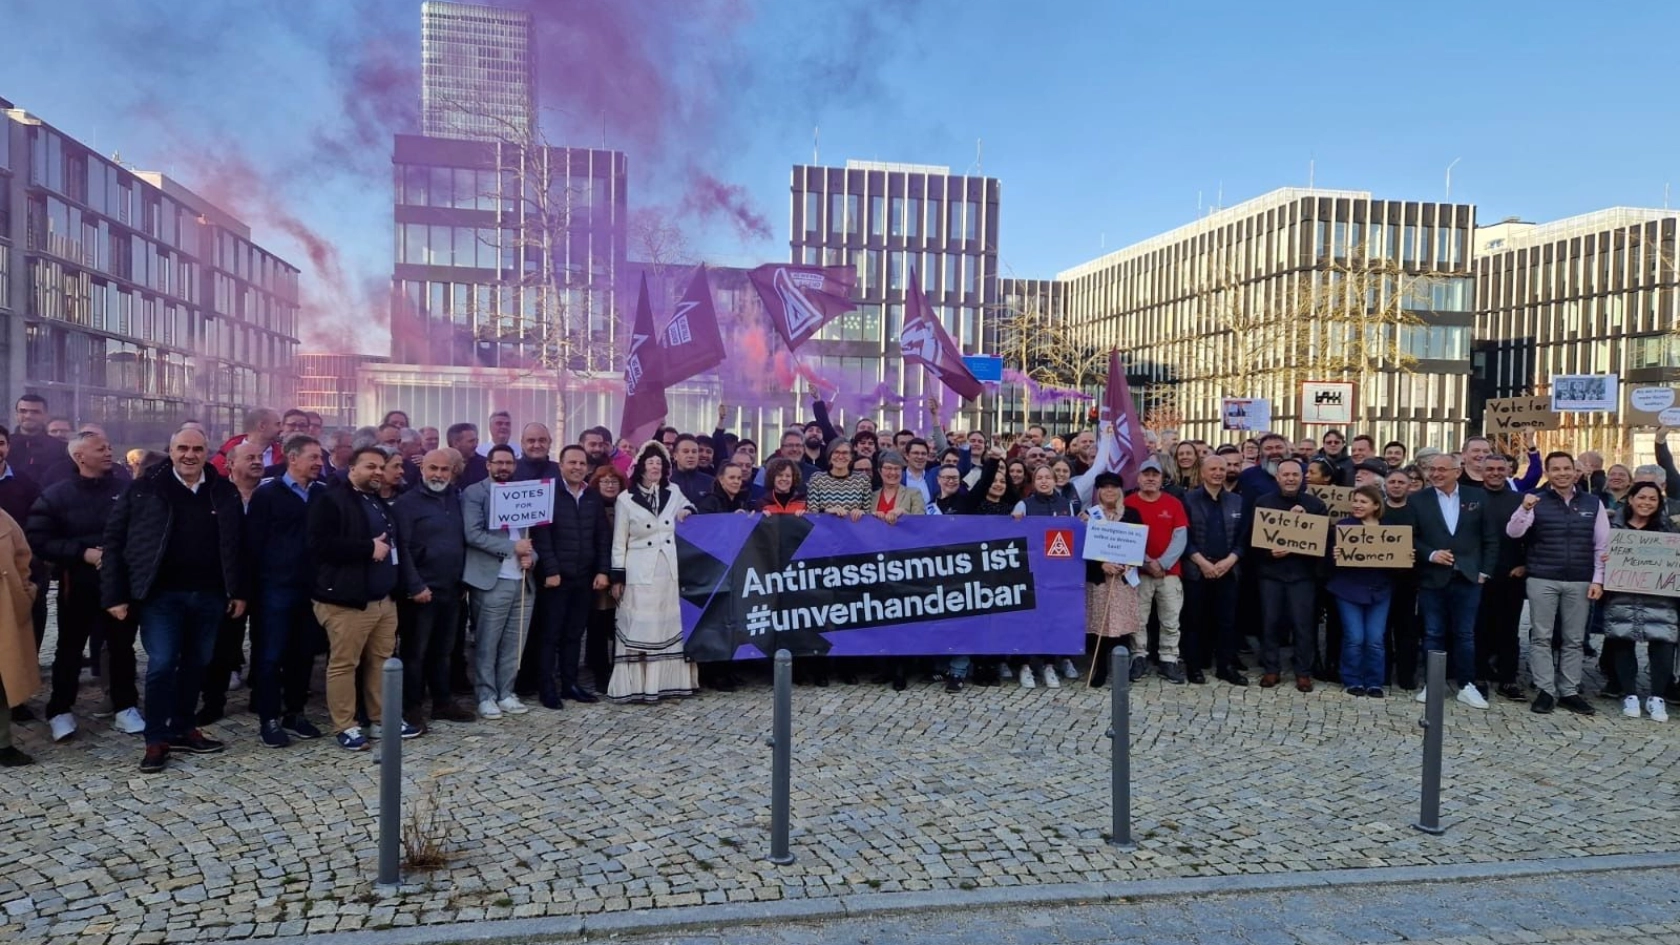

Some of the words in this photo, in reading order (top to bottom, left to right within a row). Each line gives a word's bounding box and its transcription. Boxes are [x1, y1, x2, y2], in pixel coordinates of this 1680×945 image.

[1490, 401, 1523, 413] Vote
[1529, 400, 1548, 411] for
[1496, 416, 1545, 428] Women
[503, 489, 544, 500] VOTES
[1311, 487, 1343, 501] Vote
[498, 510, 545, 522] WOMEN
[1260, 511, 1290, 526] Vote
[1294, 515, 1314, 529] for
[1263, 528, 1317, 551] Women
[1338, 527, 1374, 544] Vote
[1381, 529, 1402, 543] for
[1610, 532, 1637, 545] ALS
[1639, 535, 1662, 545] WIR
[1340, 547, 1394, 561] Women
[742, 552, 972, 598] Antirassismus
[981, 541, 1020, 571] ist
[746, 581, 1027, 636] #unverhandelbar
